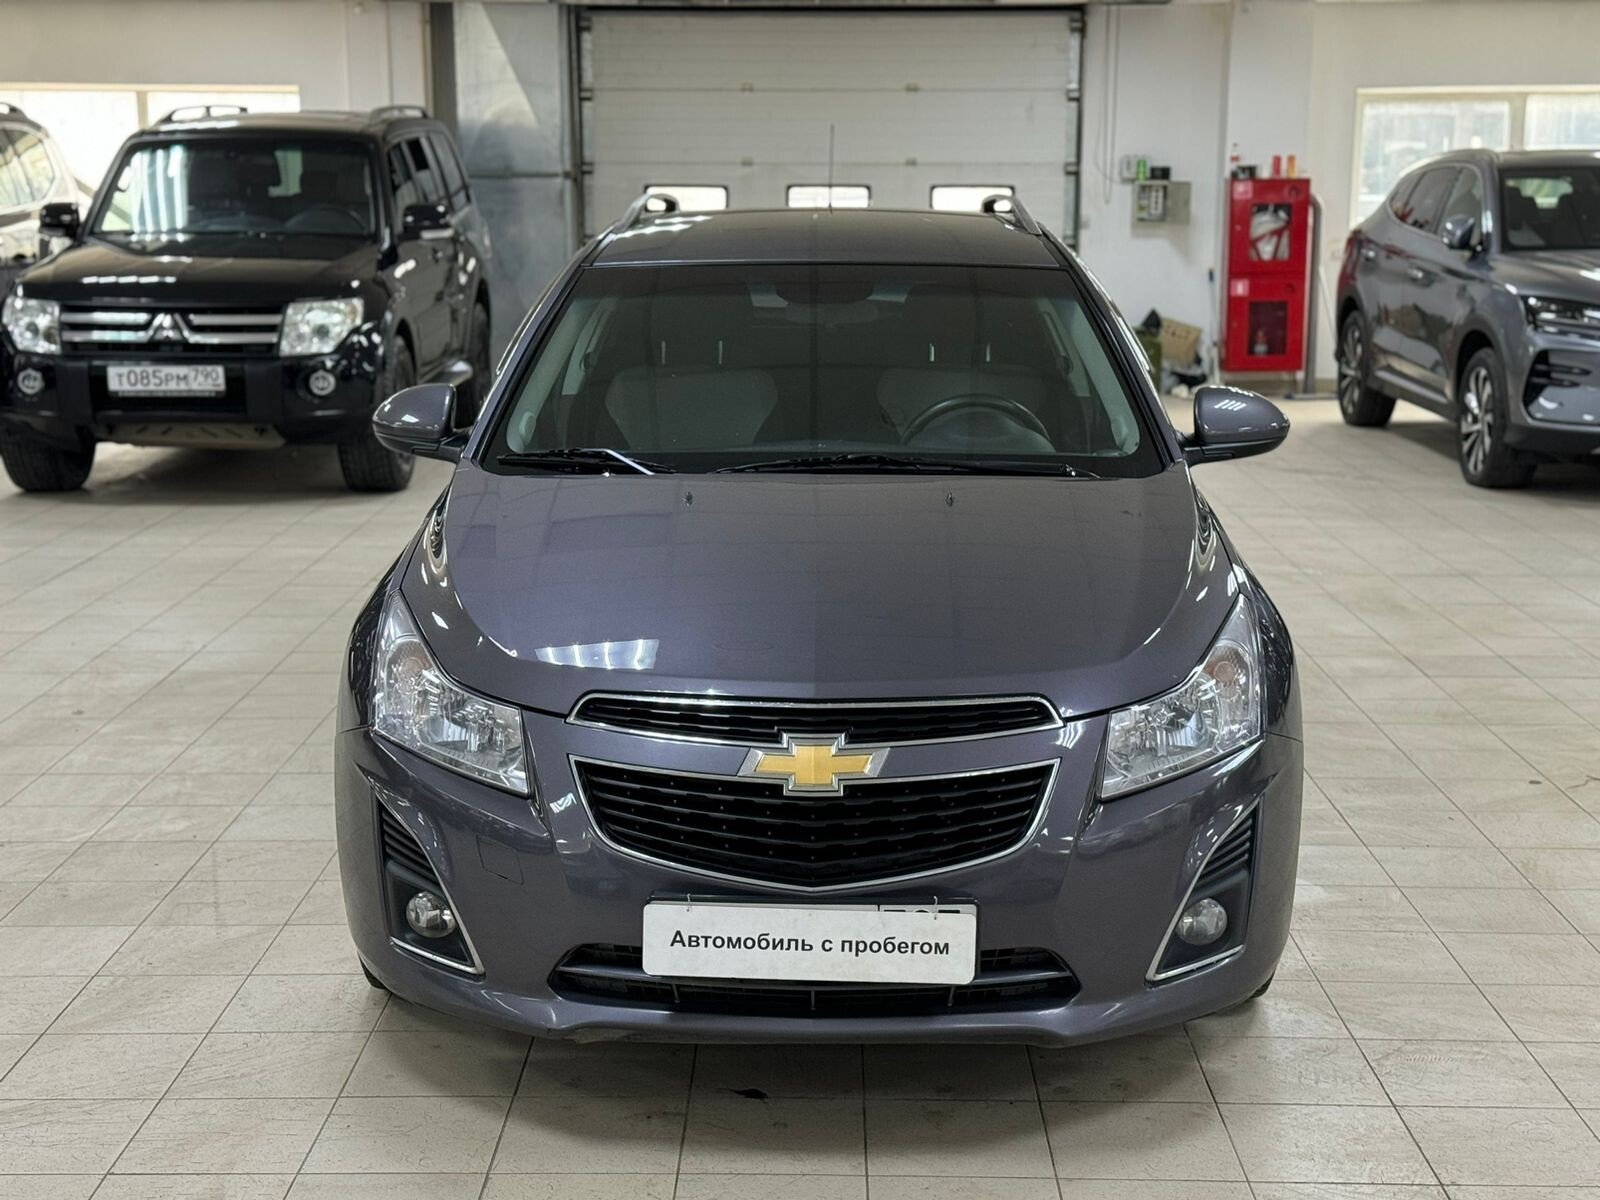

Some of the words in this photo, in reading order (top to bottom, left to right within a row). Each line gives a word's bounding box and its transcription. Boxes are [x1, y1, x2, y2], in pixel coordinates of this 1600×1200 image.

[669, 930, 814, 952] Автомобиль
[821, 939, 834, 953] с
[841, 936, 950, 957] пробегом
